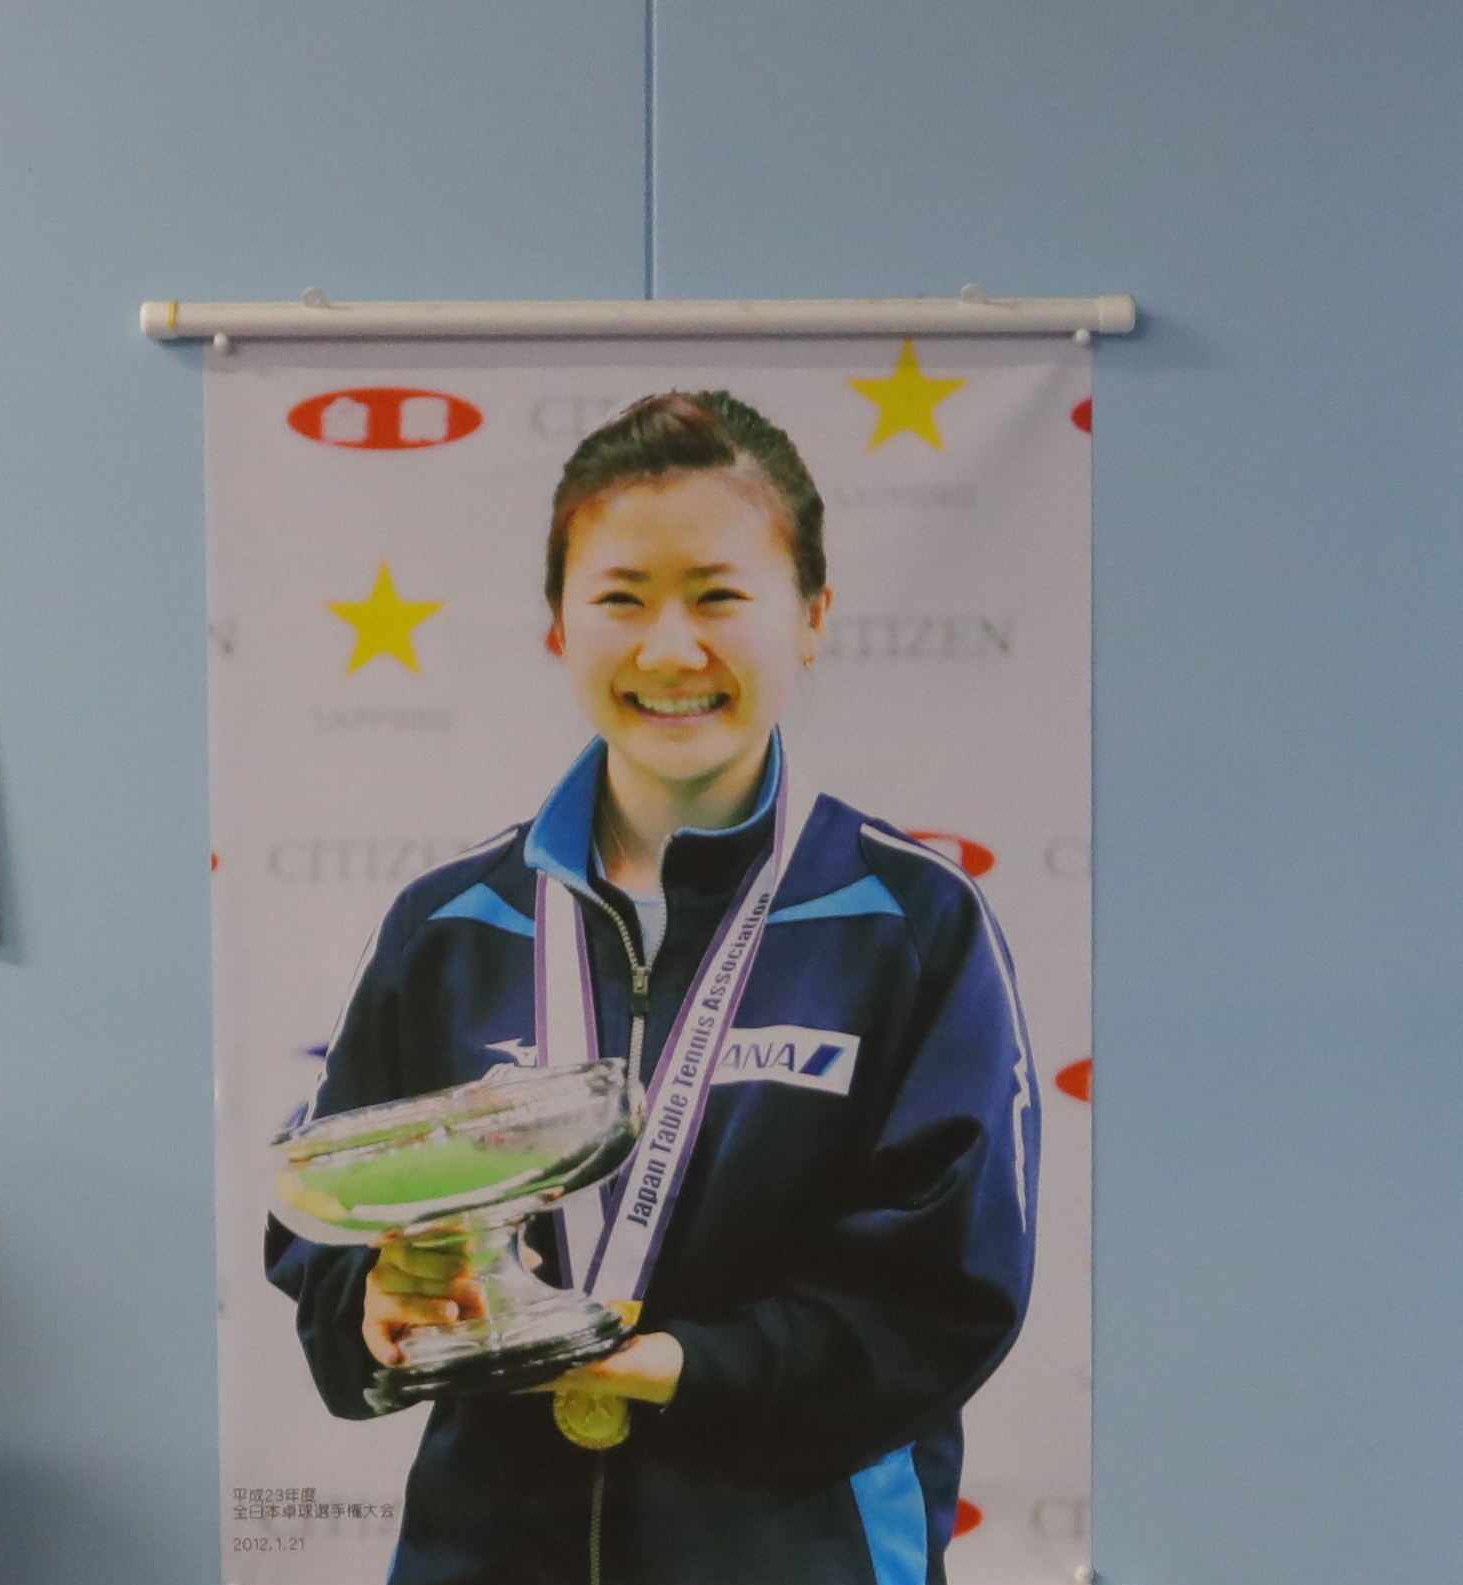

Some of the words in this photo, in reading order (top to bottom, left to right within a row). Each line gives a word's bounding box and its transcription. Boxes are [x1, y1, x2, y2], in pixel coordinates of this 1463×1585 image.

[818, 614, 1016, 658] ITIZEN
[626, 1155, 668, 1228] Japan
[650, 1090, 689, 1157] Table
[672, 1015, 715, 1097] Tennis
[701, 891, 771, 1012] Association
[717, 1042, 796, 1072] ANA
[232, 1487, 317, 1503] 平成23年度
[232, 1503, 396, 1520] 全日本卓球選手権大会
